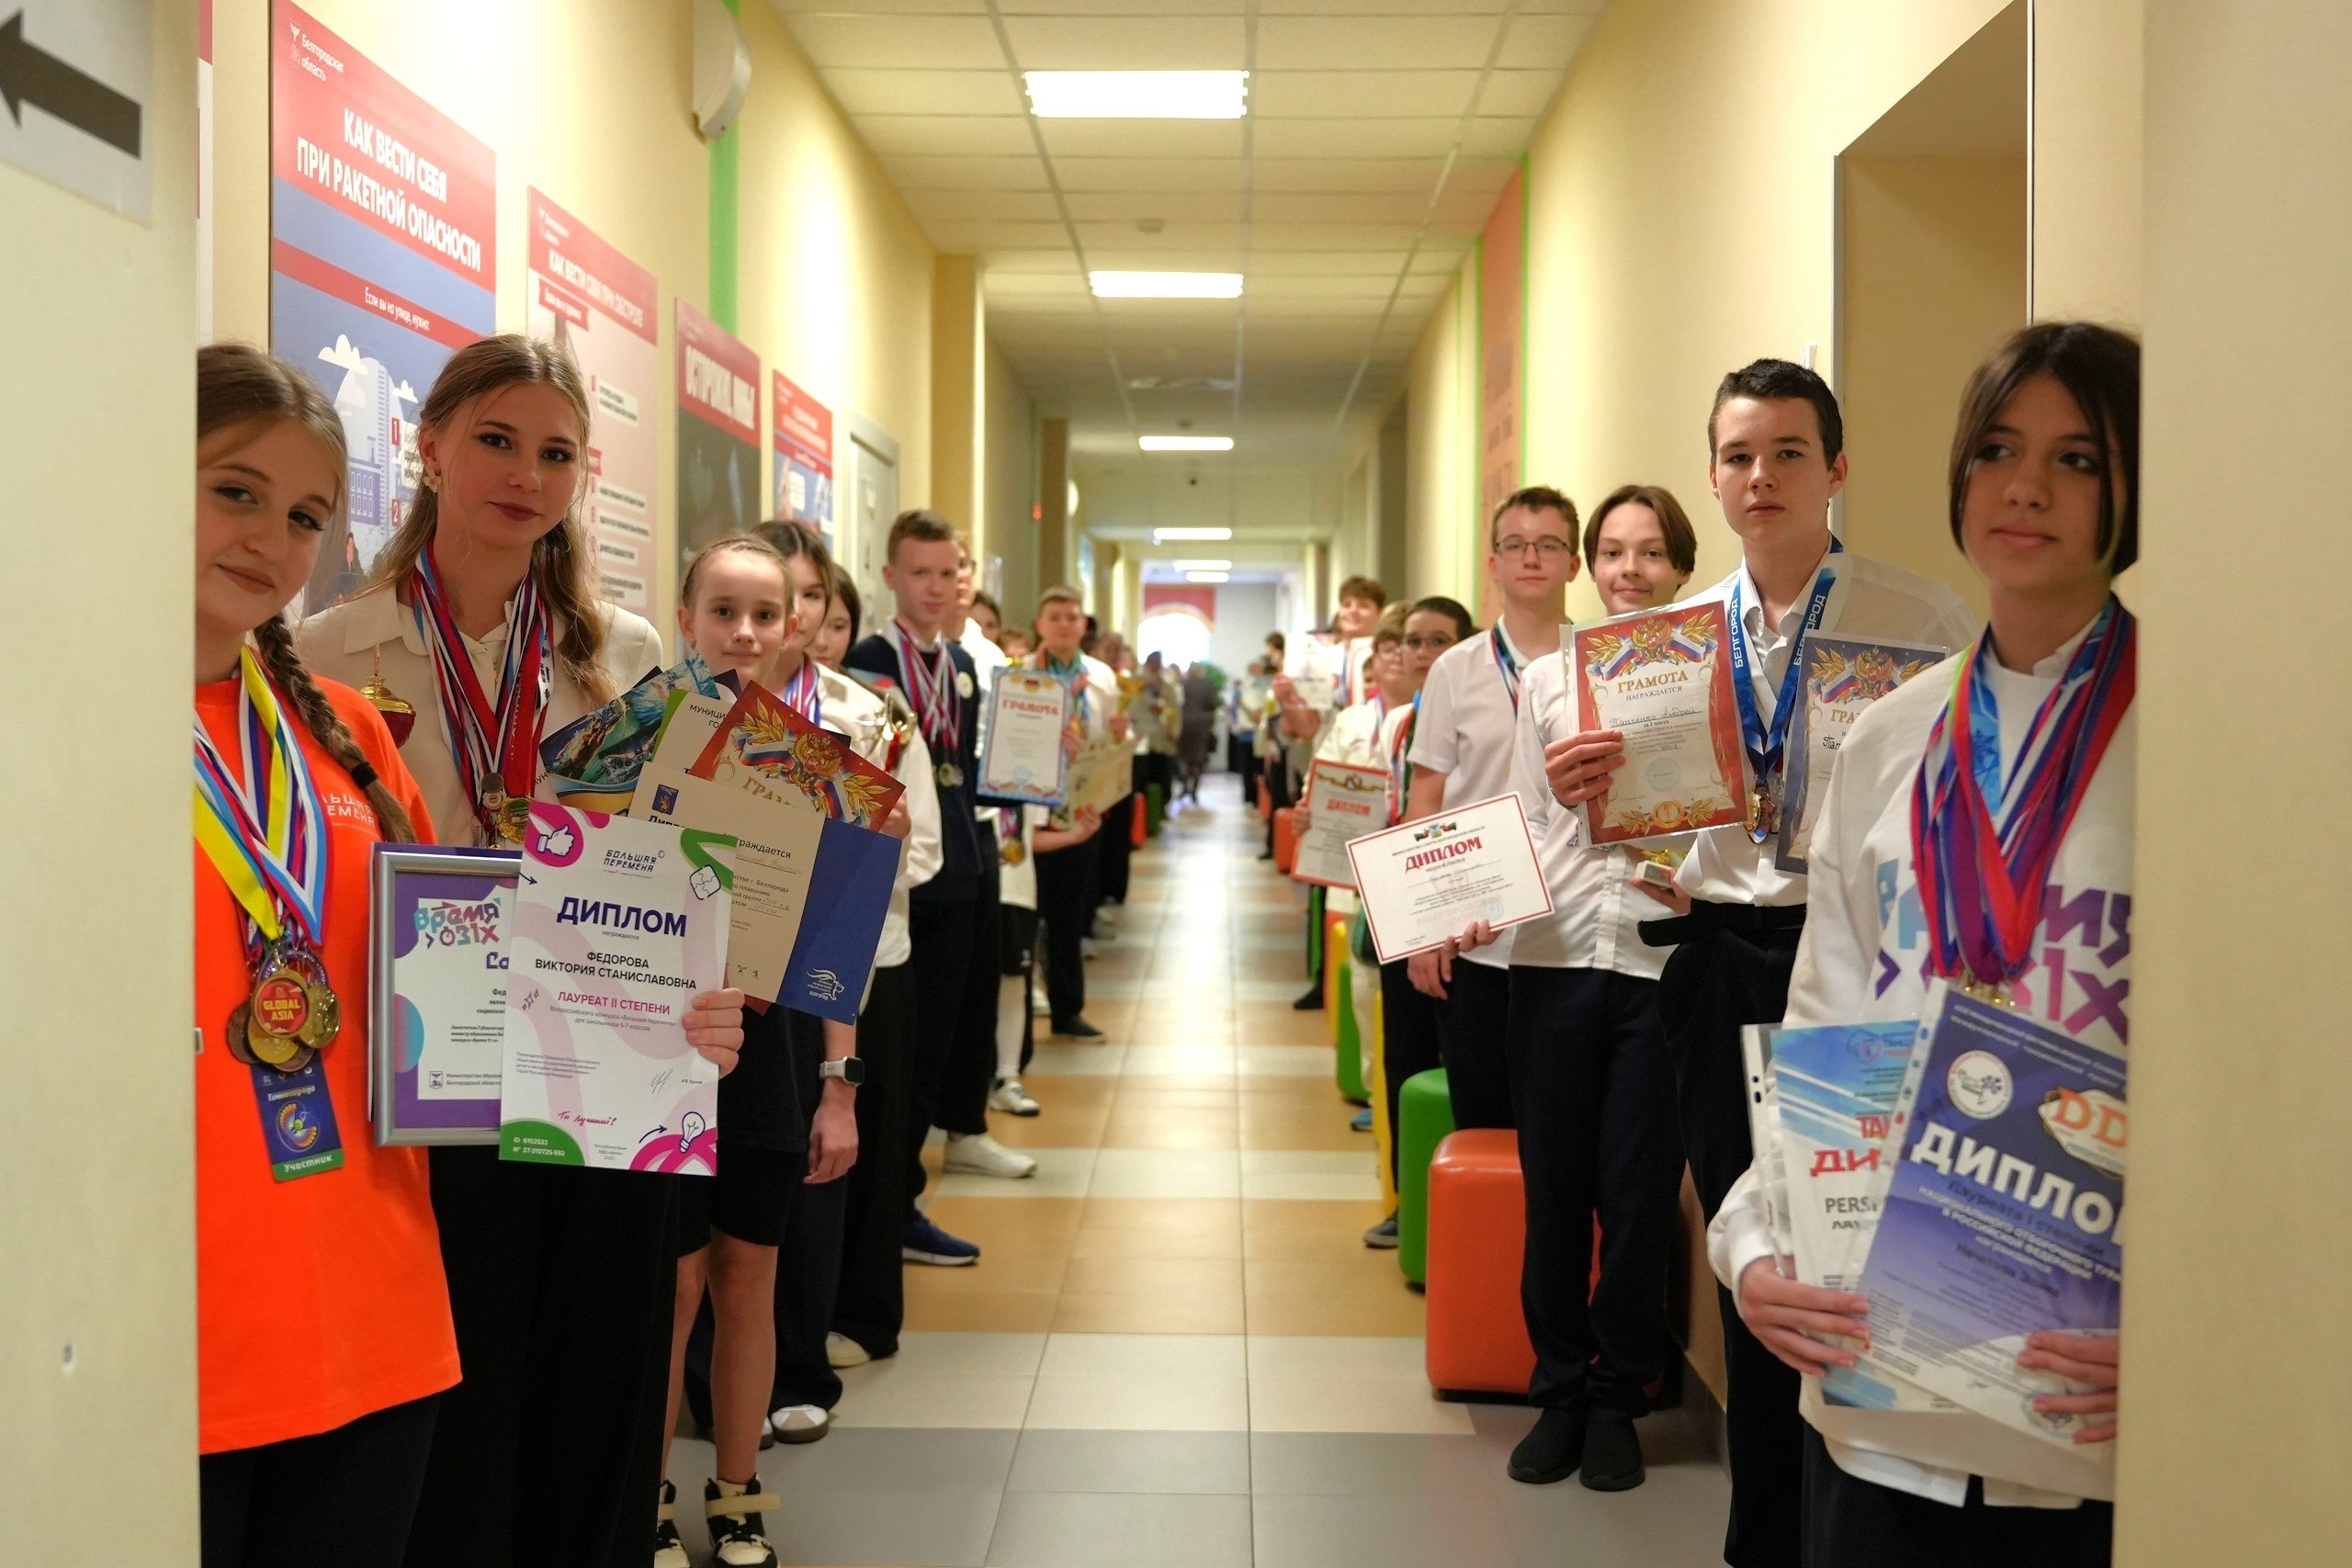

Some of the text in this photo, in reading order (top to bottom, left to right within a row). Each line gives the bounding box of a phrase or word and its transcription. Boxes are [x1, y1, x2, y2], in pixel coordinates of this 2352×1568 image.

[301, 33, 344, 73] Белгородская
[300, 56, 327, 82] область
[344, 107, 447, 203] КАК ВЕСТИ СЕБЯ
[297, 135, 481, 273] ПРИ РАКЕТНОЙ ОПАСНОСТИ
[392, 419, 400, 442] 1
[392, 501, 400, 523] 2
[1730, 597, 1744, 669] БЕЛГОРОД
[1617, 670, 1689, 694] ГРАМОТА
[1626, 684, 1682, 702] НАГРАЖДАЕТСЯ
[1830, 709, 1861, 725] ГРА
[605, 849, 657, 864] БОЛЬШАЯ
[737, 838, 792, 860] раждается
[1405, 836, 1483, 874] ДИПЛОМ
[603, 857, 654, 873] ПЕРЕМЕНА
[740, 886, 771, 897] плаванию
[756, 879, 790, 894] Белгорода
[556, 896, 687, 938] ДИПЛОМ
[602, 930, 640, 941] награждается
[587, 951, 650, 969] ФЕДОРОВА
[535, 958, 696, 990] ВИКТОРИЯ СТАНИСЛАВОВНА
[263, 998, 301, 1010] GLOBAL
[557, 991, 671, 1015] ЛАУРЕАТ II СТЕПЕНИ
[271, 1010, 295, 1021] ASIA
[585, 1019, 620, 1028] школьников
